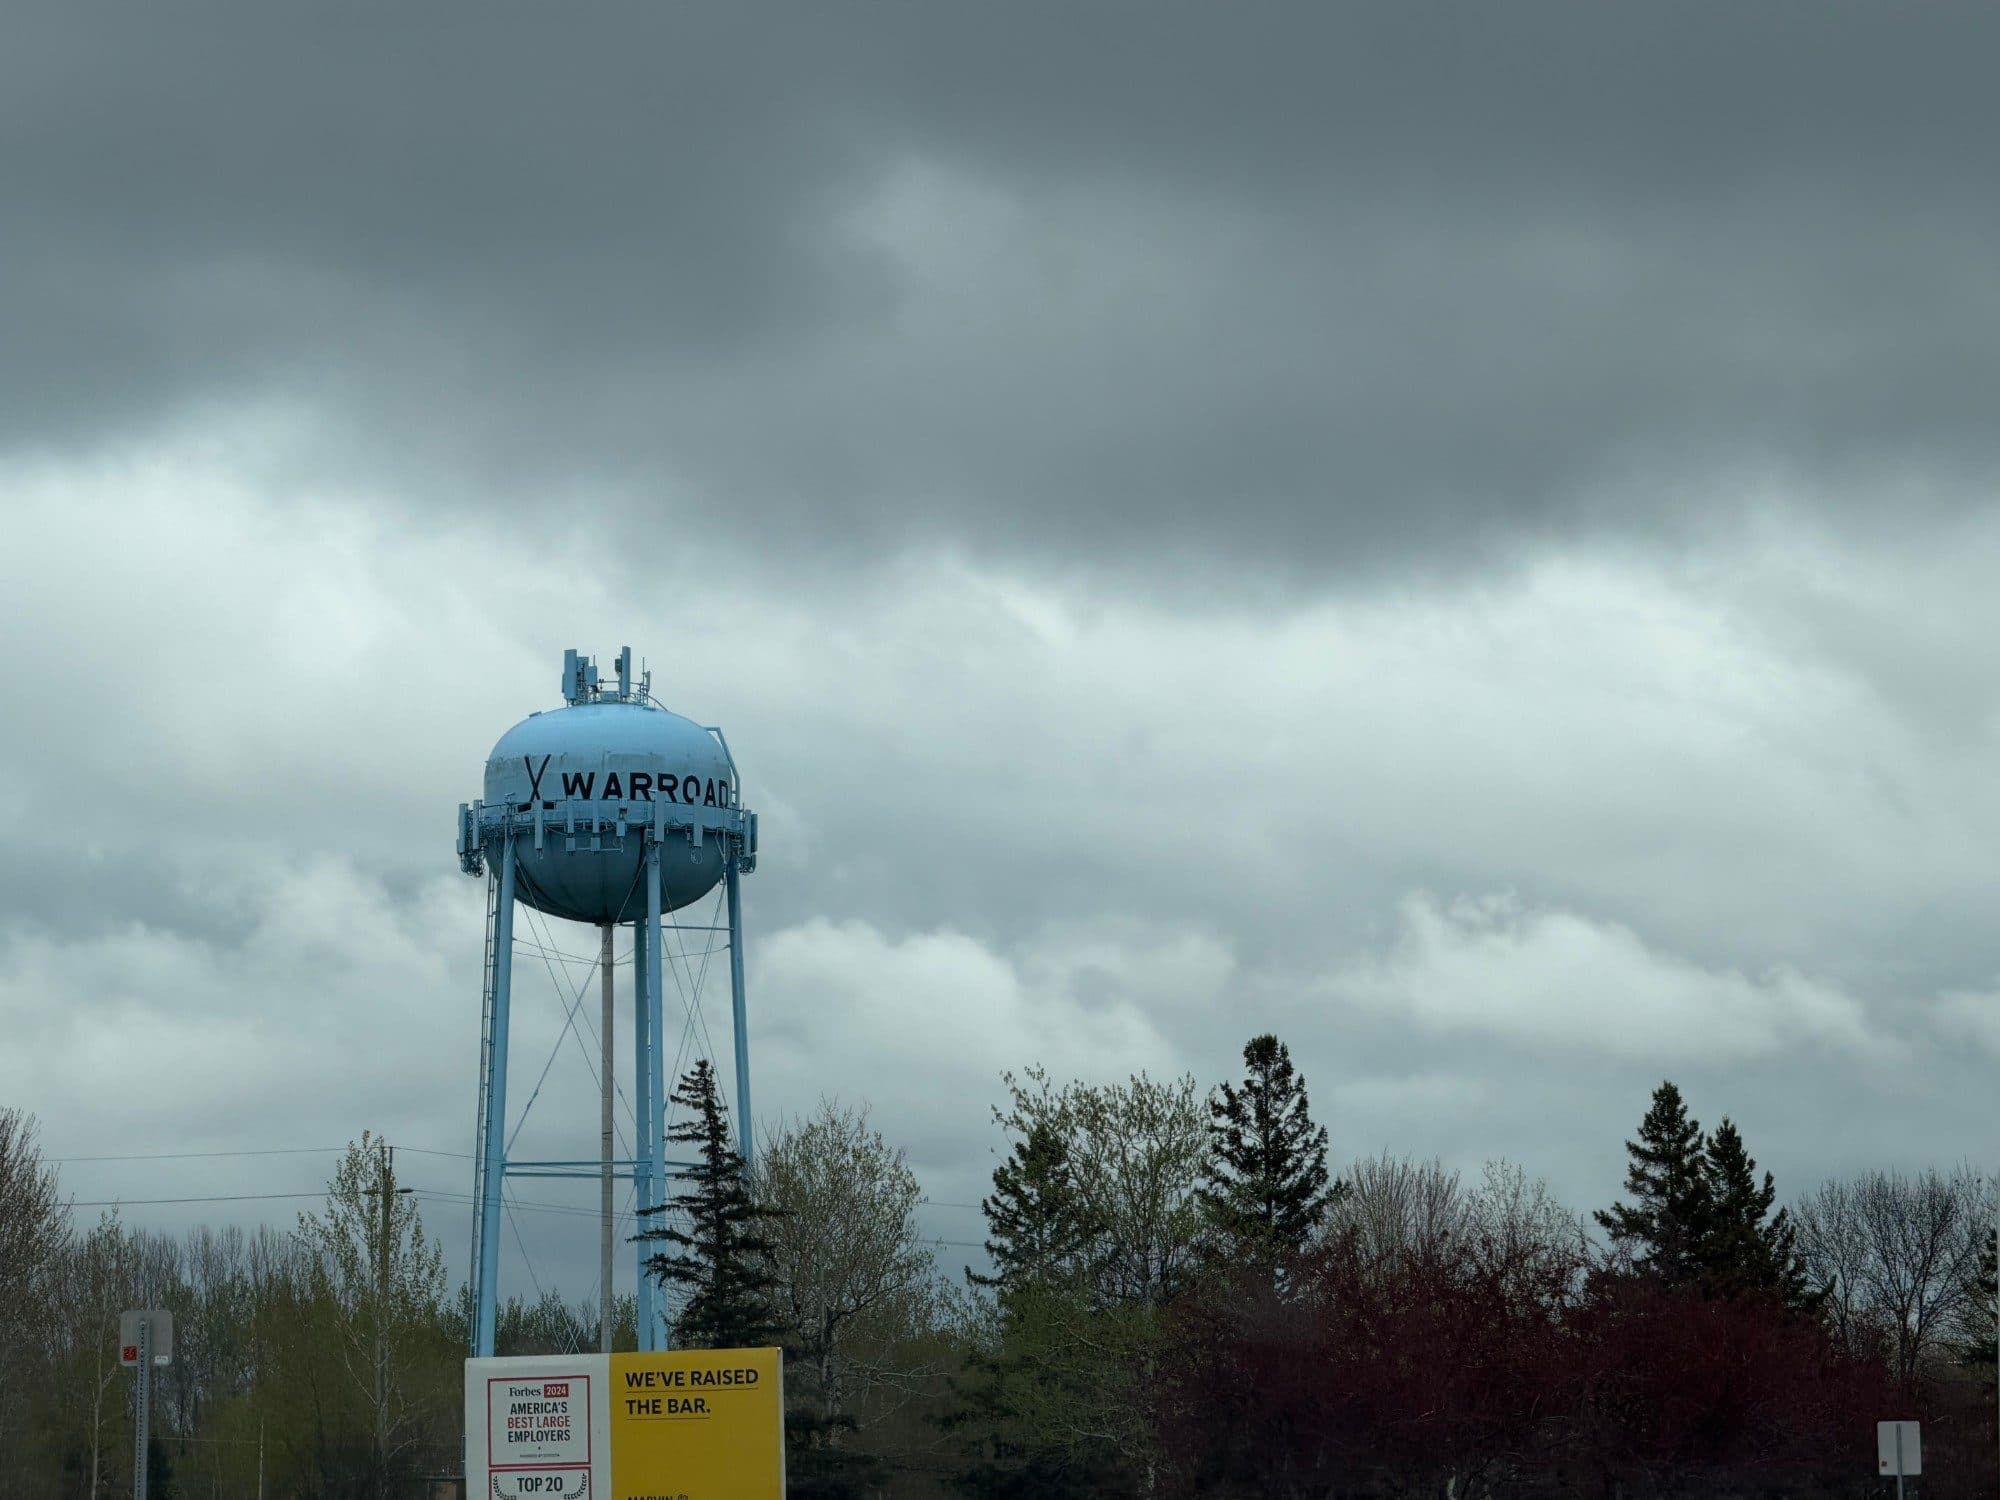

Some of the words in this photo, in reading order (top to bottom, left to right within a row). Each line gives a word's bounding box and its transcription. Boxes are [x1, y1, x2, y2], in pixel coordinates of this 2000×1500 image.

[562, 772, 728, 808] WARROAD
[626, 1371, 685, 1387] WE'VE
[690, 1369, 758, 1385] RAISED
[509, 1387, 541, 1397] Forbes
[546, 1386, 566, 1395] 2024
[511, 1402, 567, 1415] AMERICA'S
[626, 1399, 662, 1414] THE
[667, 1398, 711, 1413] BAR.
[508, 1417, 534, 1428] BEST
[537, 1416, 570, 1428] LARGE
[508, 1430, 570, 1442] EMPLOYERS
[517, 1478, 542, 1492] TOP
[546, 1477, 563, 1491] 20
